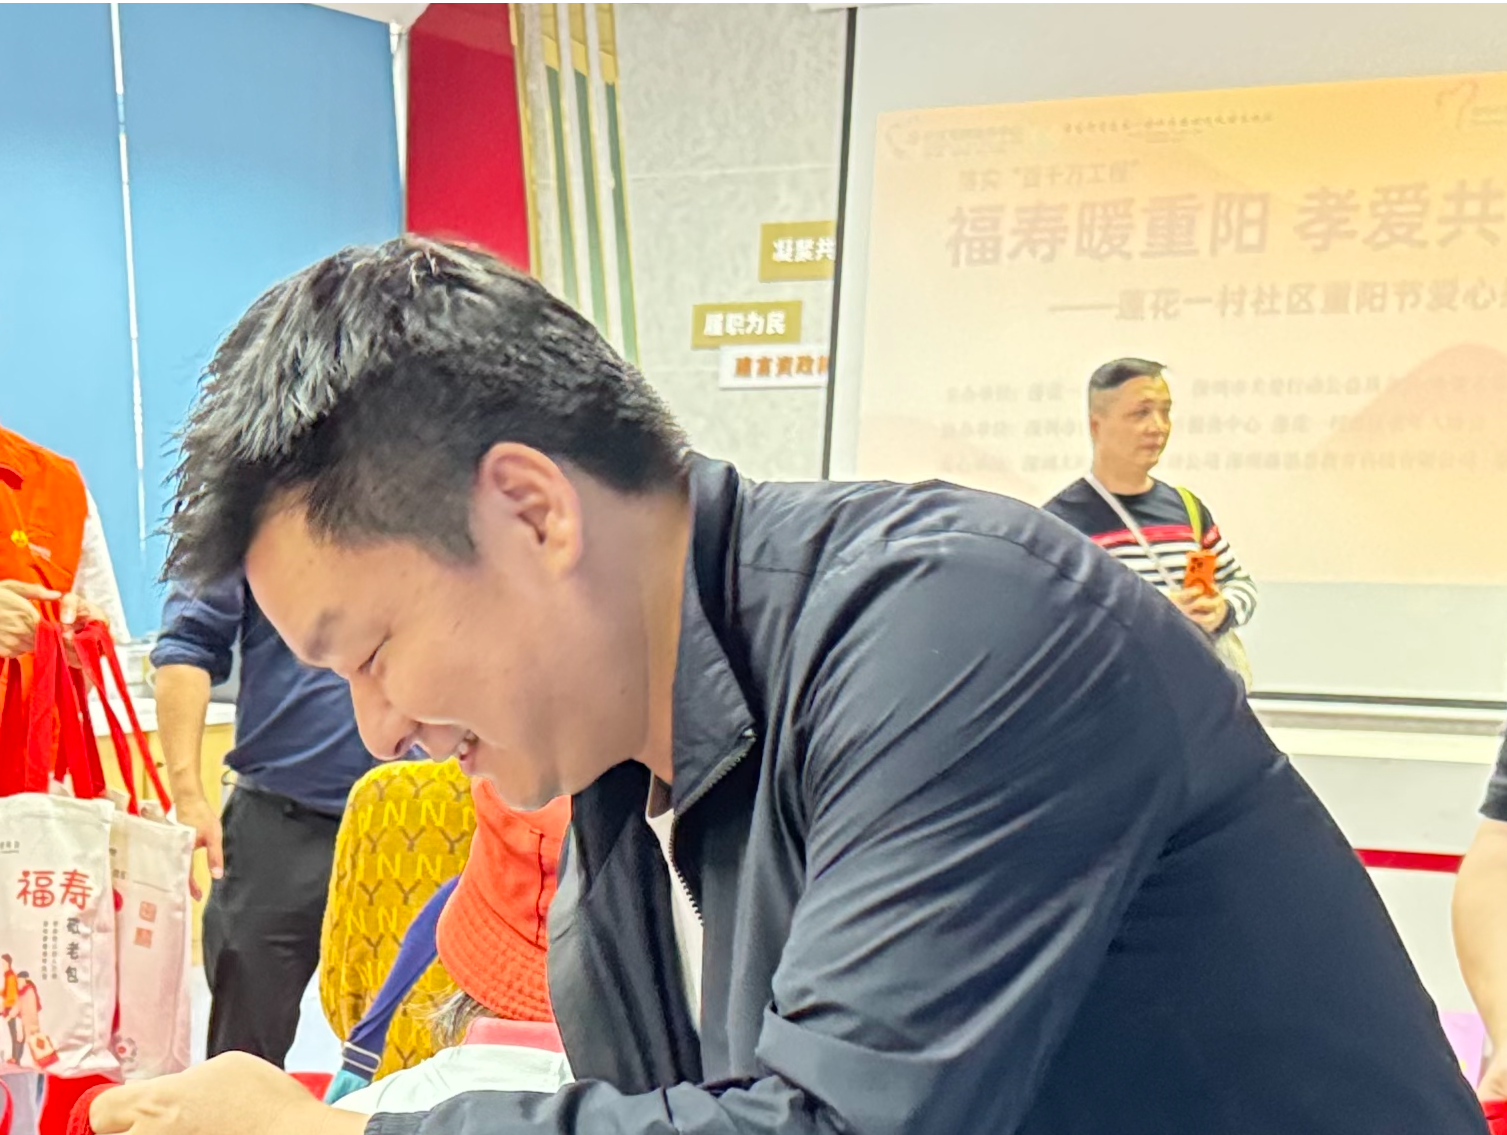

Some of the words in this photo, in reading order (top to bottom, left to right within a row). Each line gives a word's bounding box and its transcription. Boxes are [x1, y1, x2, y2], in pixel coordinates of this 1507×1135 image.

[945, 194, 1271, 268] 福寿暖重阳
[1292, 177, 1505, 252] 孝爱共
[16, 868, 94, 911] 福寿
